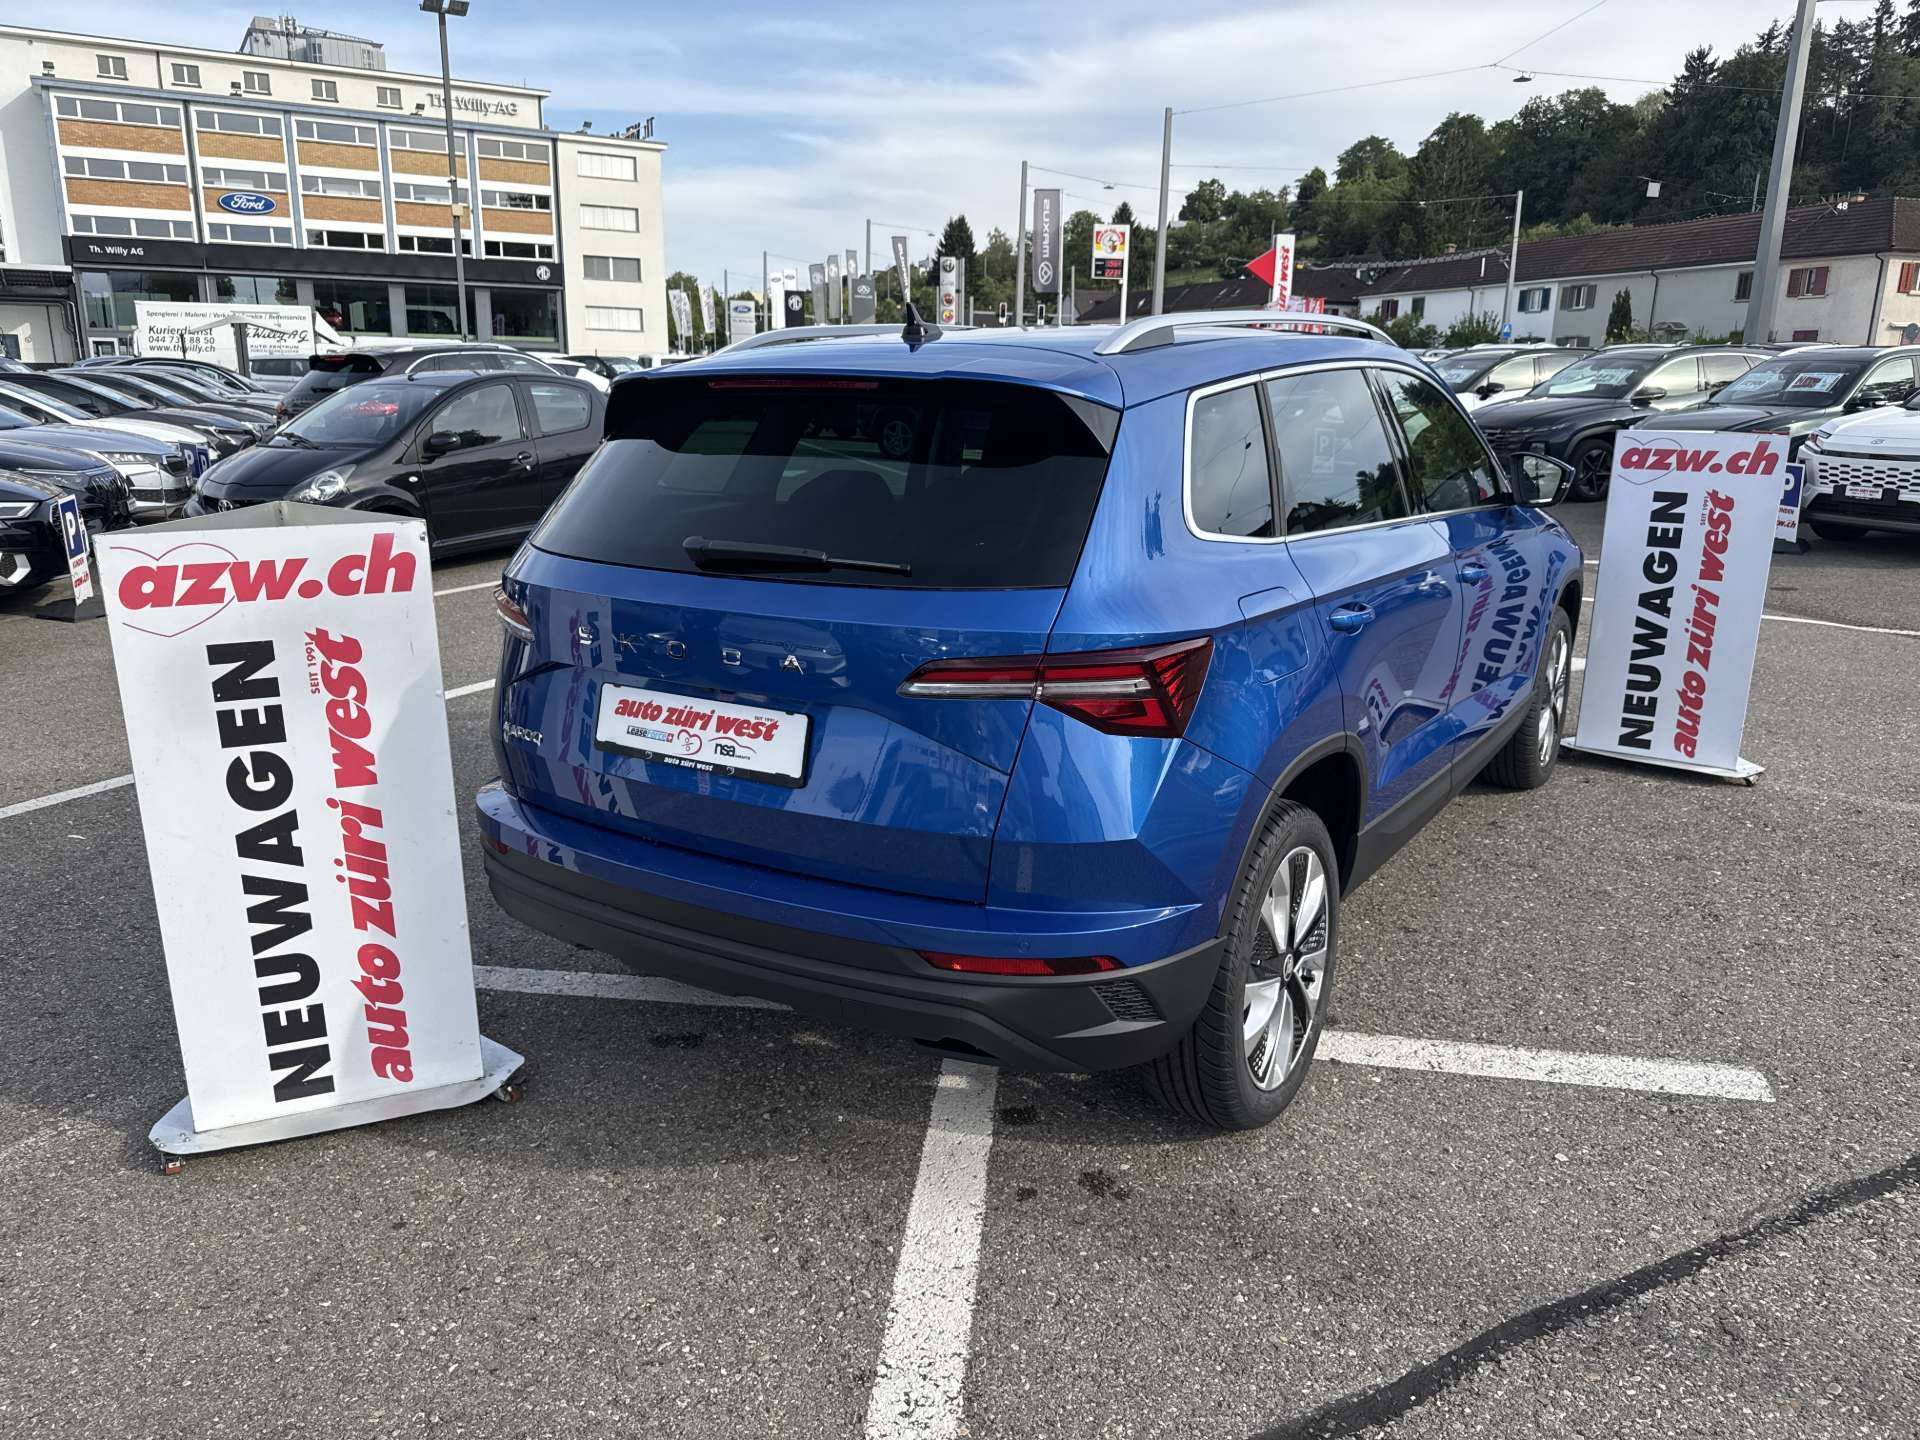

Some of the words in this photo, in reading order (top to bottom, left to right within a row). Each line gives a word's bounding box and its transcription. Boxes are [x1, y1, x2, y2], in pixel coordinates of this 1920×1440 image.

[455, 96, 490, 116] Willy
[495, 101, 518, 116] AG
[230, 194, 265, 211] Ford
[1043, 198, 1051, 258] MAXUS
[88, 244, 103, 254] Th.
[105, 246, 128, 257] Willy
[130, 246, 144, 256] AG
[536, 265, 551, 281] MG
[788, 294, 802, 311] MG
[148, 335, 166, 344] 044
[203, 337, 215, 345] 50
[184, 449, 195, 469] P
[1620, 441, 1779, 475] azw.ch
[1702, 495, 1710, 510] 1991
[65, 511, 76, 550] P
[1698, 489, 1735, 581] west
[118, 533, 417, 610] azw.ch
[1618, 491, 1688, 750] NEUWAGEN
[1684, 584, 1720, 672] züri
[304, 641, 318, 667] 1991
[308, 671, 320, 694] SEIT
[304, 627, 378, 788] west
[614, 696, 663, 722] auto
[661, 704, 715, 731] züri
[715, 715, 780, 741] west
[1674, 671, 1706, 758] auto
[663, 756, 680, 765] auto
[679, 759, 696, 769] züri
[696, 763, 714, 772] west
[714, 743, 736, 758] nsa
[206, 640, 335, 1103] NEUWAGEN
[325, 797, 397, 938] züri
[351, 943, 414, 1083] auto
